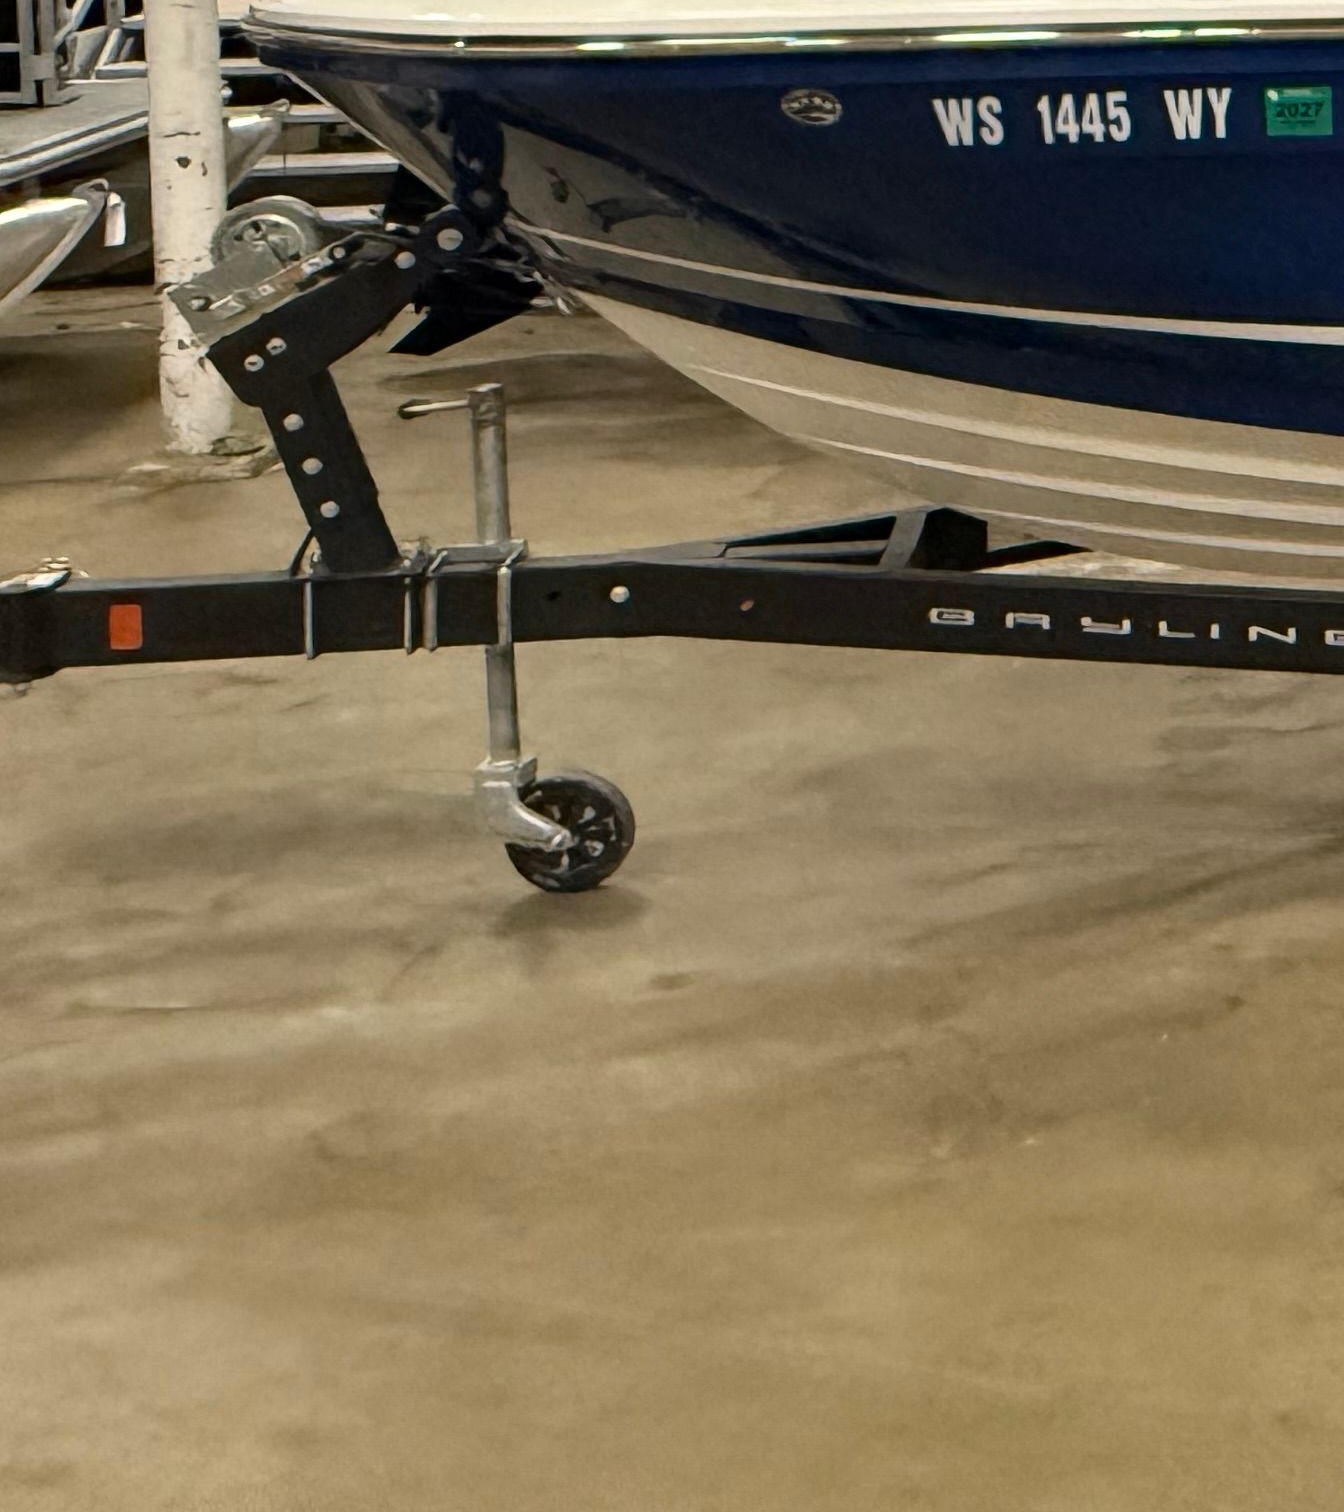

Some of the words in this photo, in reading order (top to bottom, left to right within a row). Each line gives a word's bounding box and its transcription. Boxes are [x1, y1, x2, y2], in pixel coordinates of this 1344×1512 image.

[931, 95, 1004, 147] WS
[1037, 90, 1132, 144] 1445
[1163, 87, 1233, 141] WY
